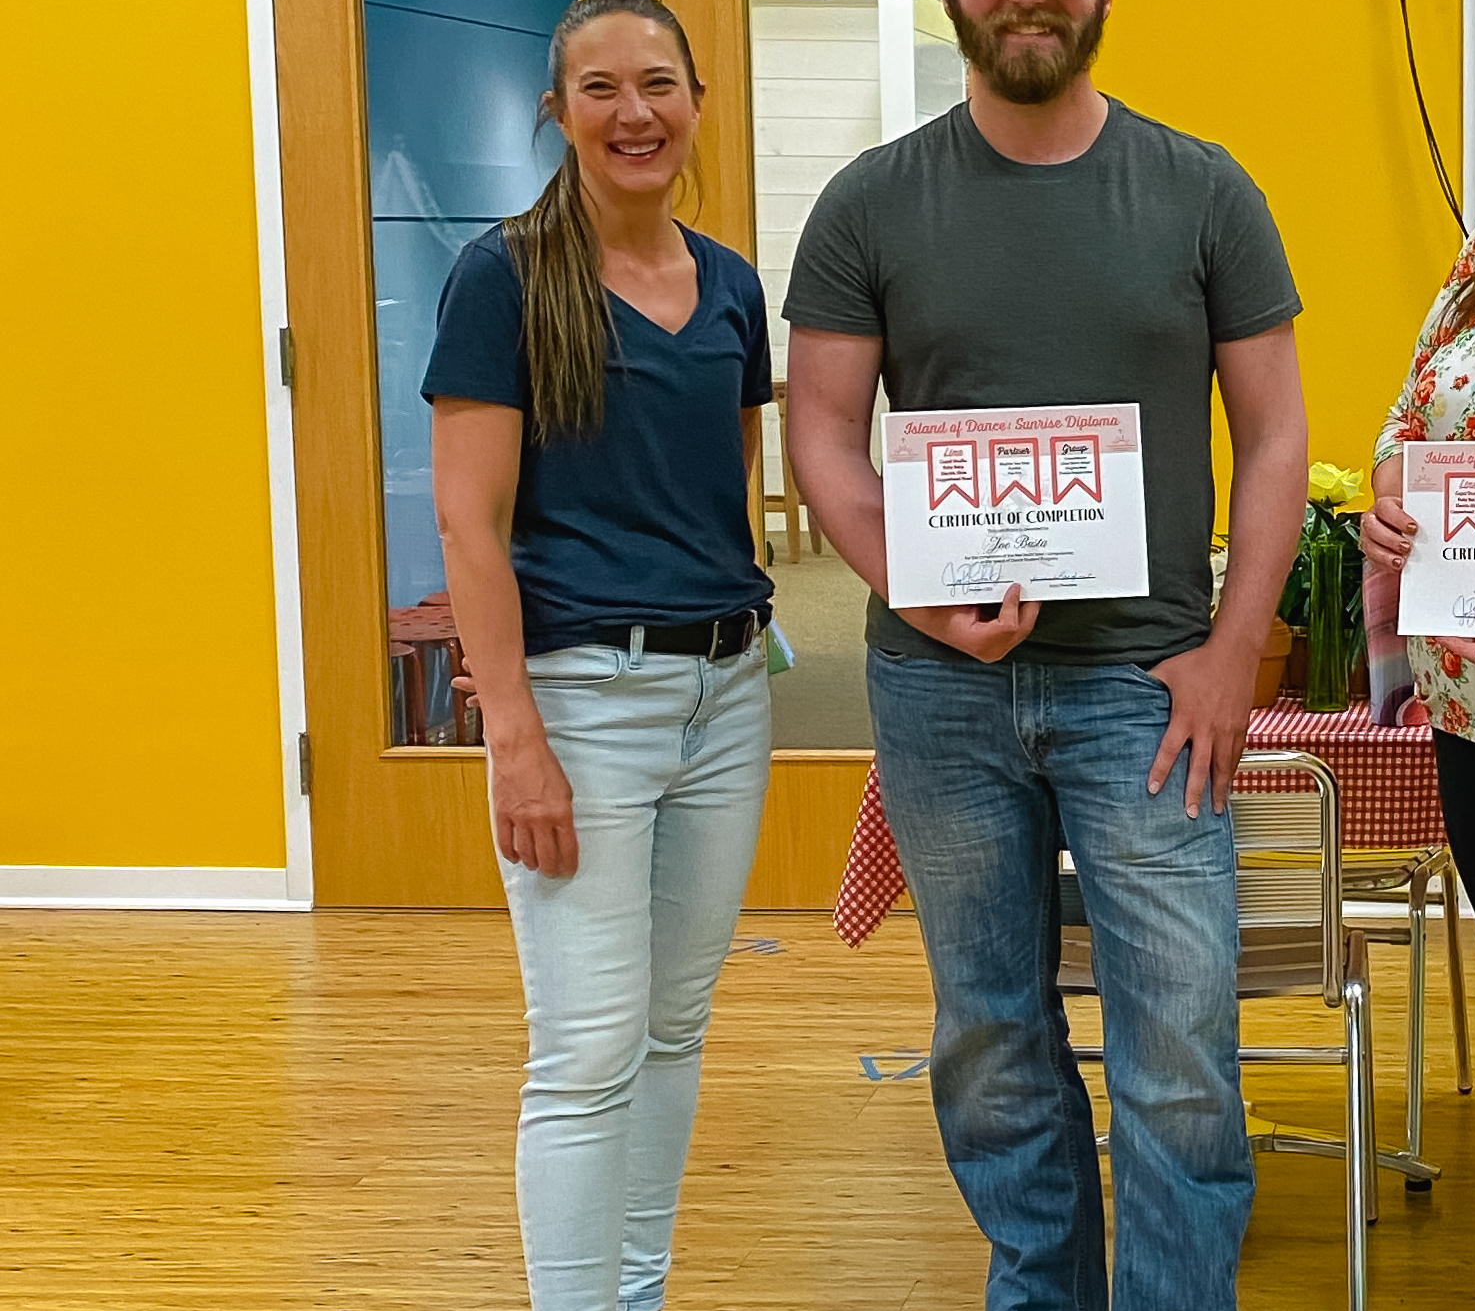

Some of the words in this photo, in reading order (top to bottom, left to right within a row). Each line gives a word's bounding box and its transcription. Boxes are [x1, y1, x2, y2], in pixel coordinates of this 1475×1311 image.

[903, 420, 948, 435] Island
[950, 419, 963, 438] of
[1015, 417, 1062, 431] Sunrise
[1064, 414, 1120, 431] Diploma
[996, 445, 1031, 457] Partner
[1062, 444, 1089, 456] Group
[1424, 451, 1465, 465] Island
[928, 512, 1002, 529] CERTIFICATE
[1007, 511, 1022, 525] OF
[1026, 508, 1105, 523] COMPLETION
[986, 537, 1011, 554] Joe
